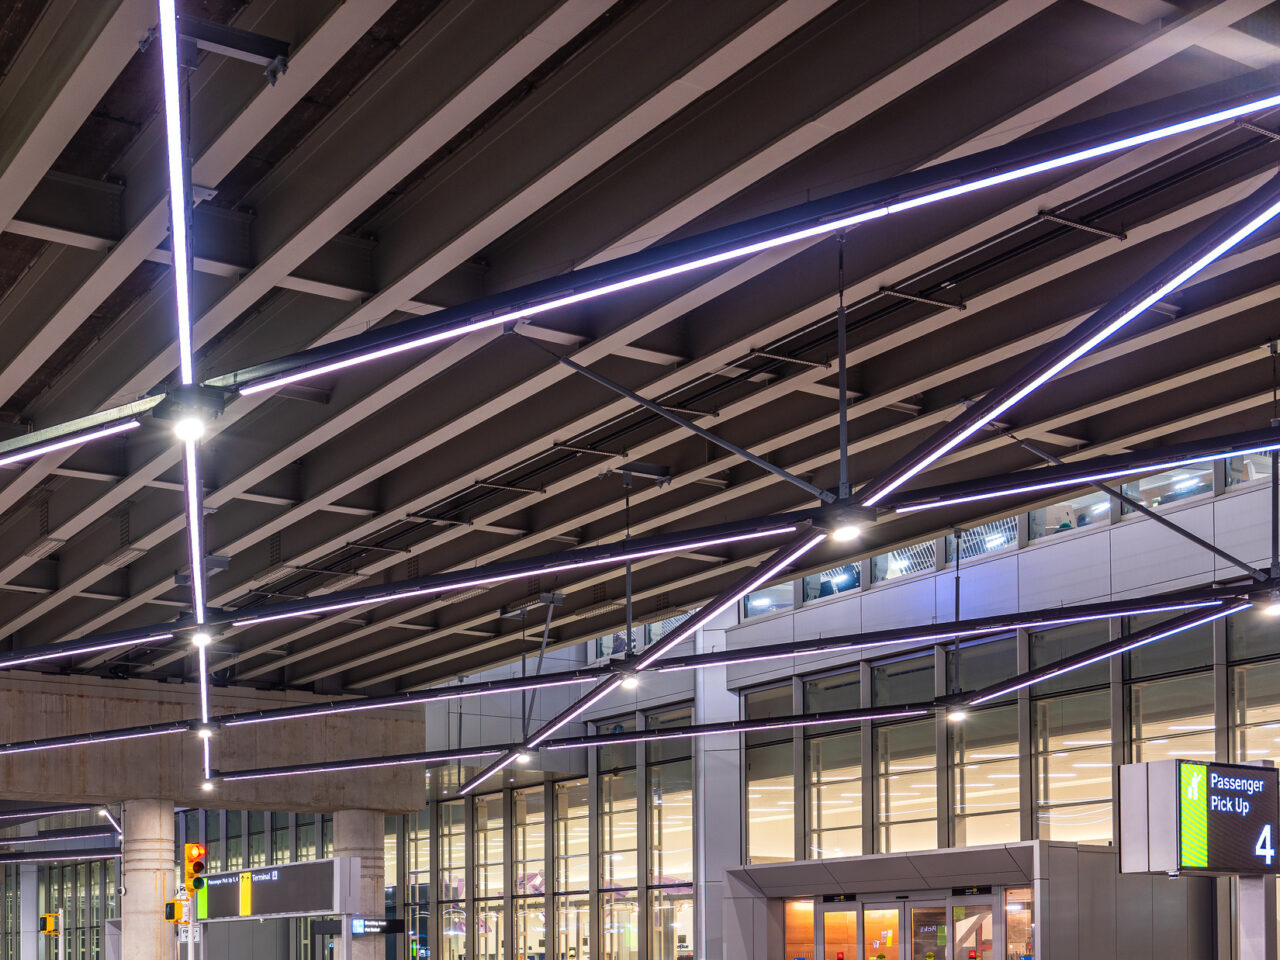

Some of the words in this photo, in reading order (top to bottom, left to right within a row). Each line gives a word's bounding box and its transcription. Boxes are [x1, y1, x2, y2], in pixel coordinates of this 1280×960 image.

[1210, 773, 1264, 795] Passenger
[1211, 795, 1233, 812] Pick
[1235, 797, 1250, 817] Up
[1255, 824, 1275, 865] 4
[252, 873, 271, 882] Terminal
